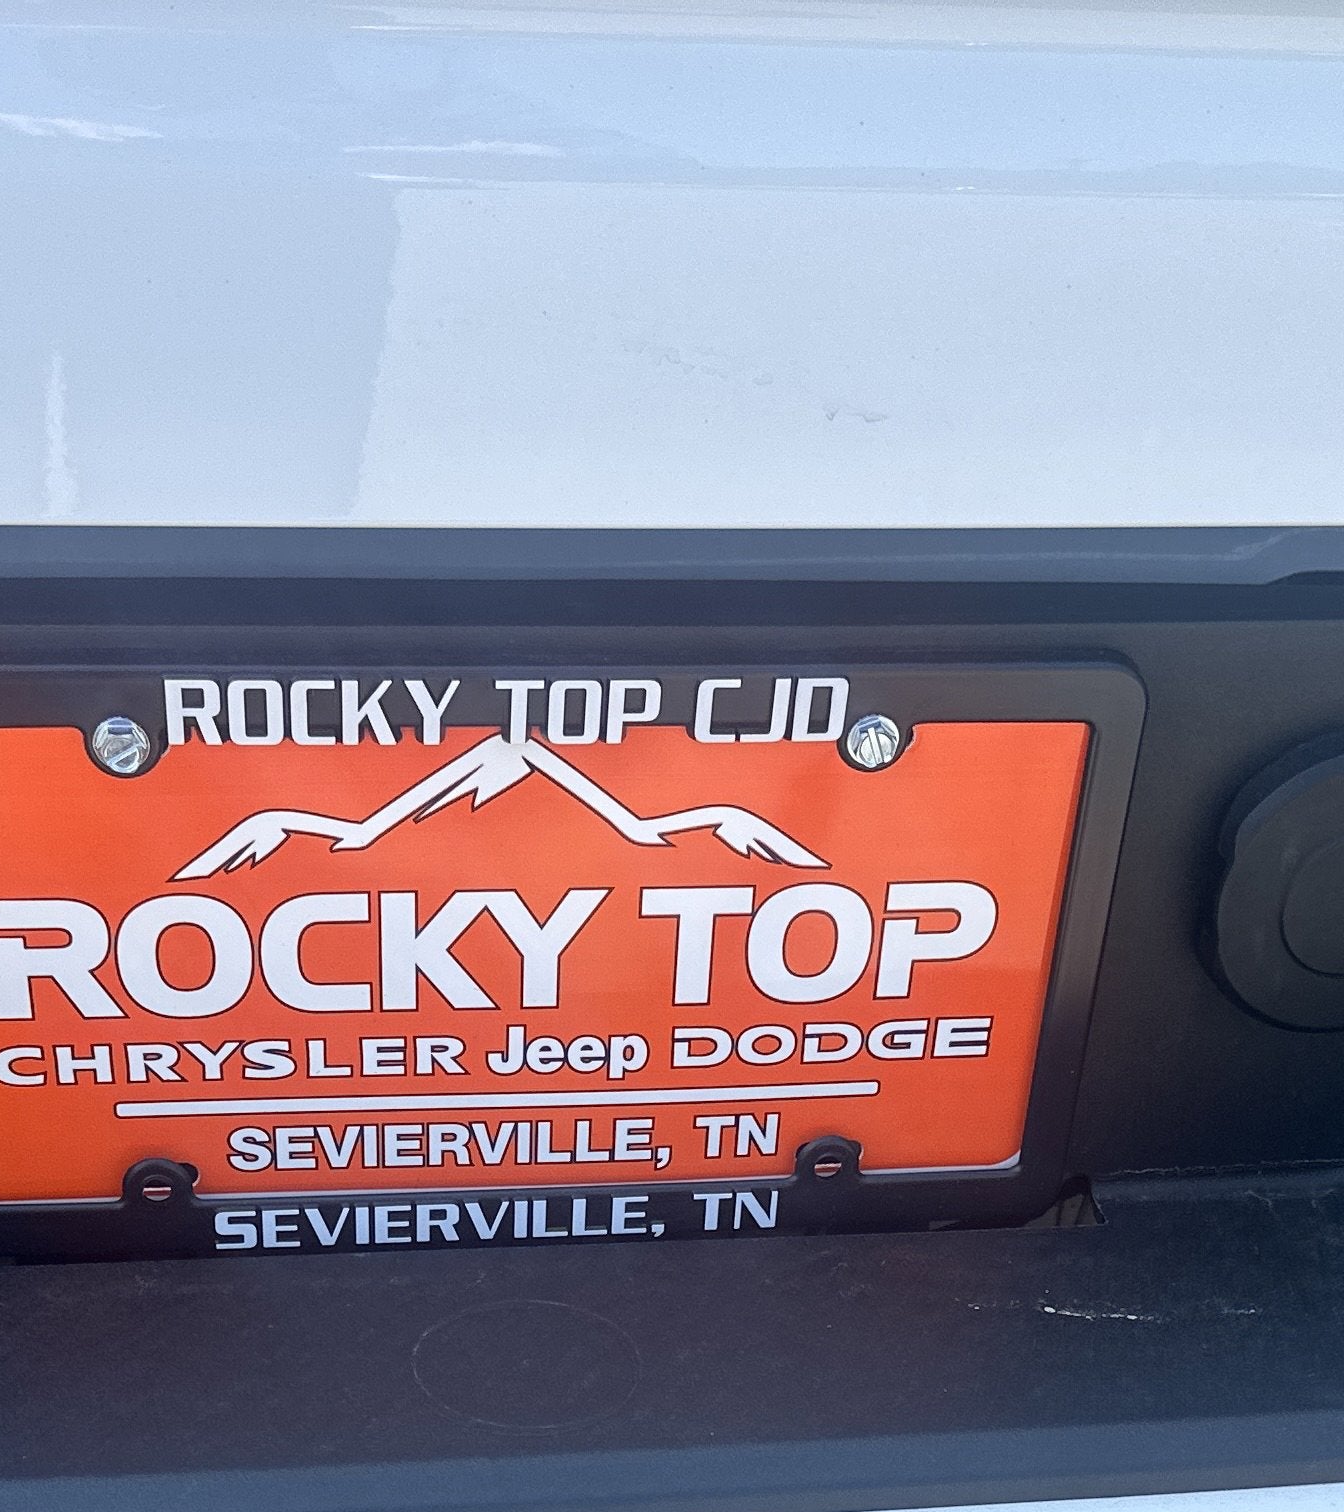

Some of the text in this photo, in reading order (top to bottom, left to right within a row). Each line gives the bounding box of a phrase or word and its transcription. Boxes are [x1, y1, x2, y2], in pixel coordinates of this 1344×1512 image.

[164, 677, 850, 746] ROCKY TOP CJD
[639, 880, 998, 1006] TOP
[486, 1025, 650, 1080] Jeep
[671, 1016, 994, 1069] DODGE
[227, 1112, 781, 1172] SEVIERVILLE, TN
[214, 1190, 779, 1250] SEVIERVILLE, TN
